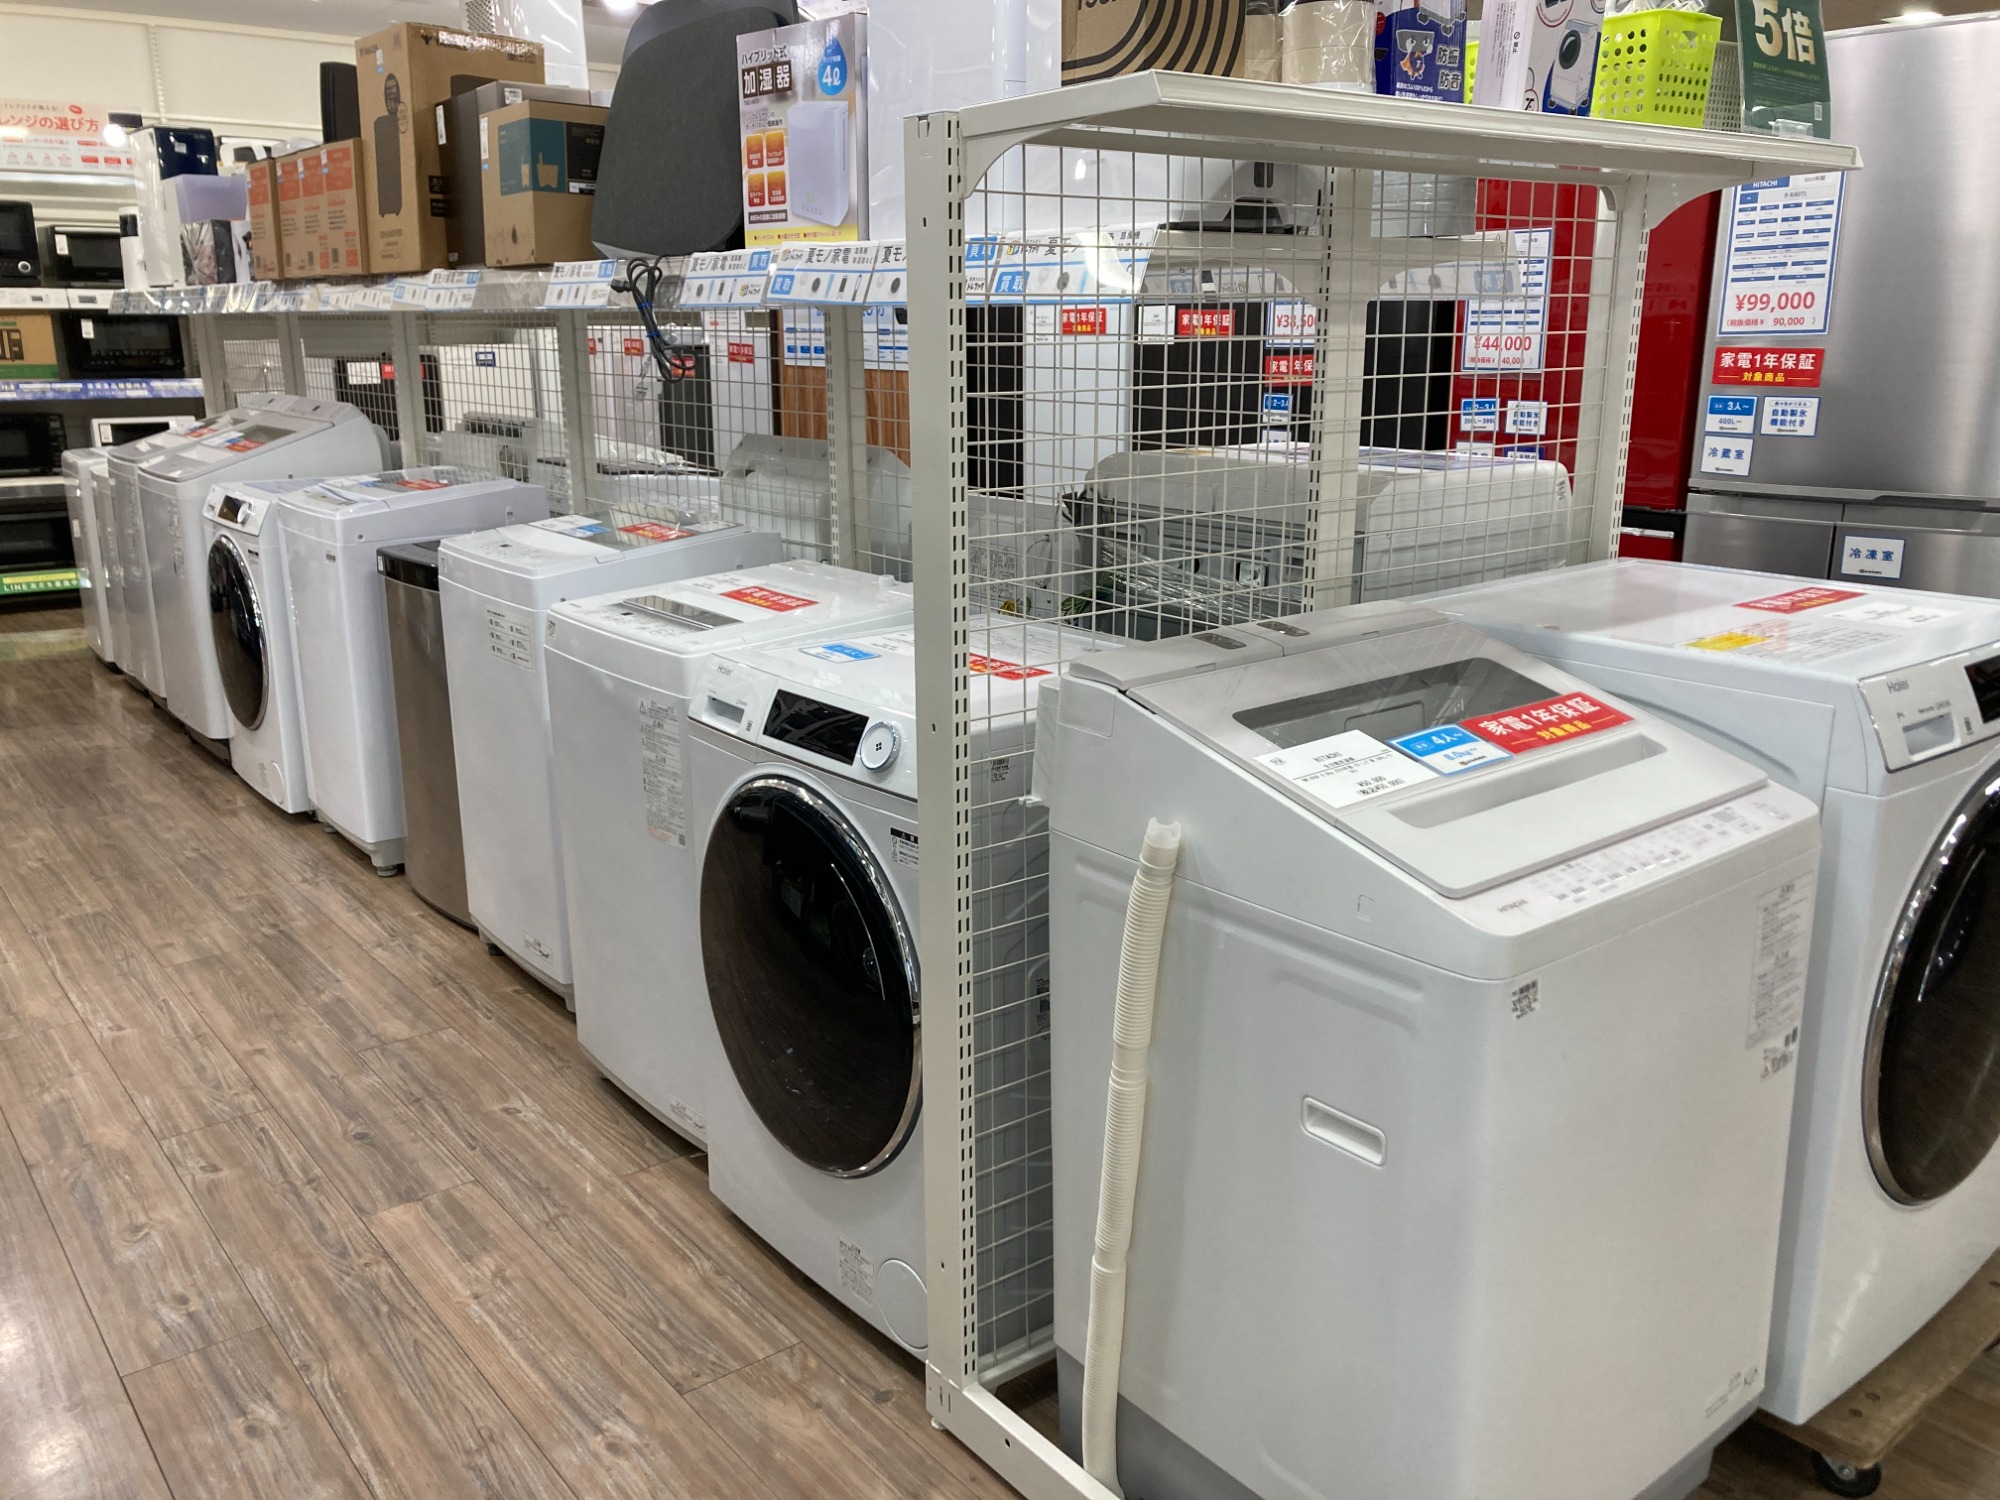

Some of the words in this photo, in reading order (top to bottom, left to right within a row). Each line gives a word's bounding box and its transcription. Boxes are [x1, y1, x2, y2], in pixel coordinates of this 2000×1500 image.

[742, 46, 788, 64] ハイブリッド式
[743, 64, 791, 95] 加湿器
[1438, 69, 1461, 91] 防音
[1752, 180, 1778, 188] HITACHI
[690, 255, 728, 272] 夏モノ家電
[751, 254, 769, 268] 買取
[805, 247, 852, 264] 夏モノ家電
[773, 277, 792, 292] 買取
[999, 276, 1025, 292] 買取
[1735, 291, 1816, 313] ¥99,000
[1773, 317, 1805, 327] 90,000
[1473, 335, 1532, 351] ¥44,000
[1720, 351, 1816, 370] 家電1年保証
[1742, 371, 1785, 383] 対象商品
[1771, 409, 1808, 417] 自動製氷
[1770, 418, 1806, 428] 機能付き
[1708, 446, 1745, 460] 冷蔵室
[1849, 547, 1895, 562] 冷凍室
[1886, 678, 1910, 694] Haier
[1479, 697, 1601, 736] 家電1年保証
[1536, 719, 1593, 741] 対象商品
[1312, 751, 1344, 764] HITACHI
[1496, 898, 1529, 913] HITACHI
